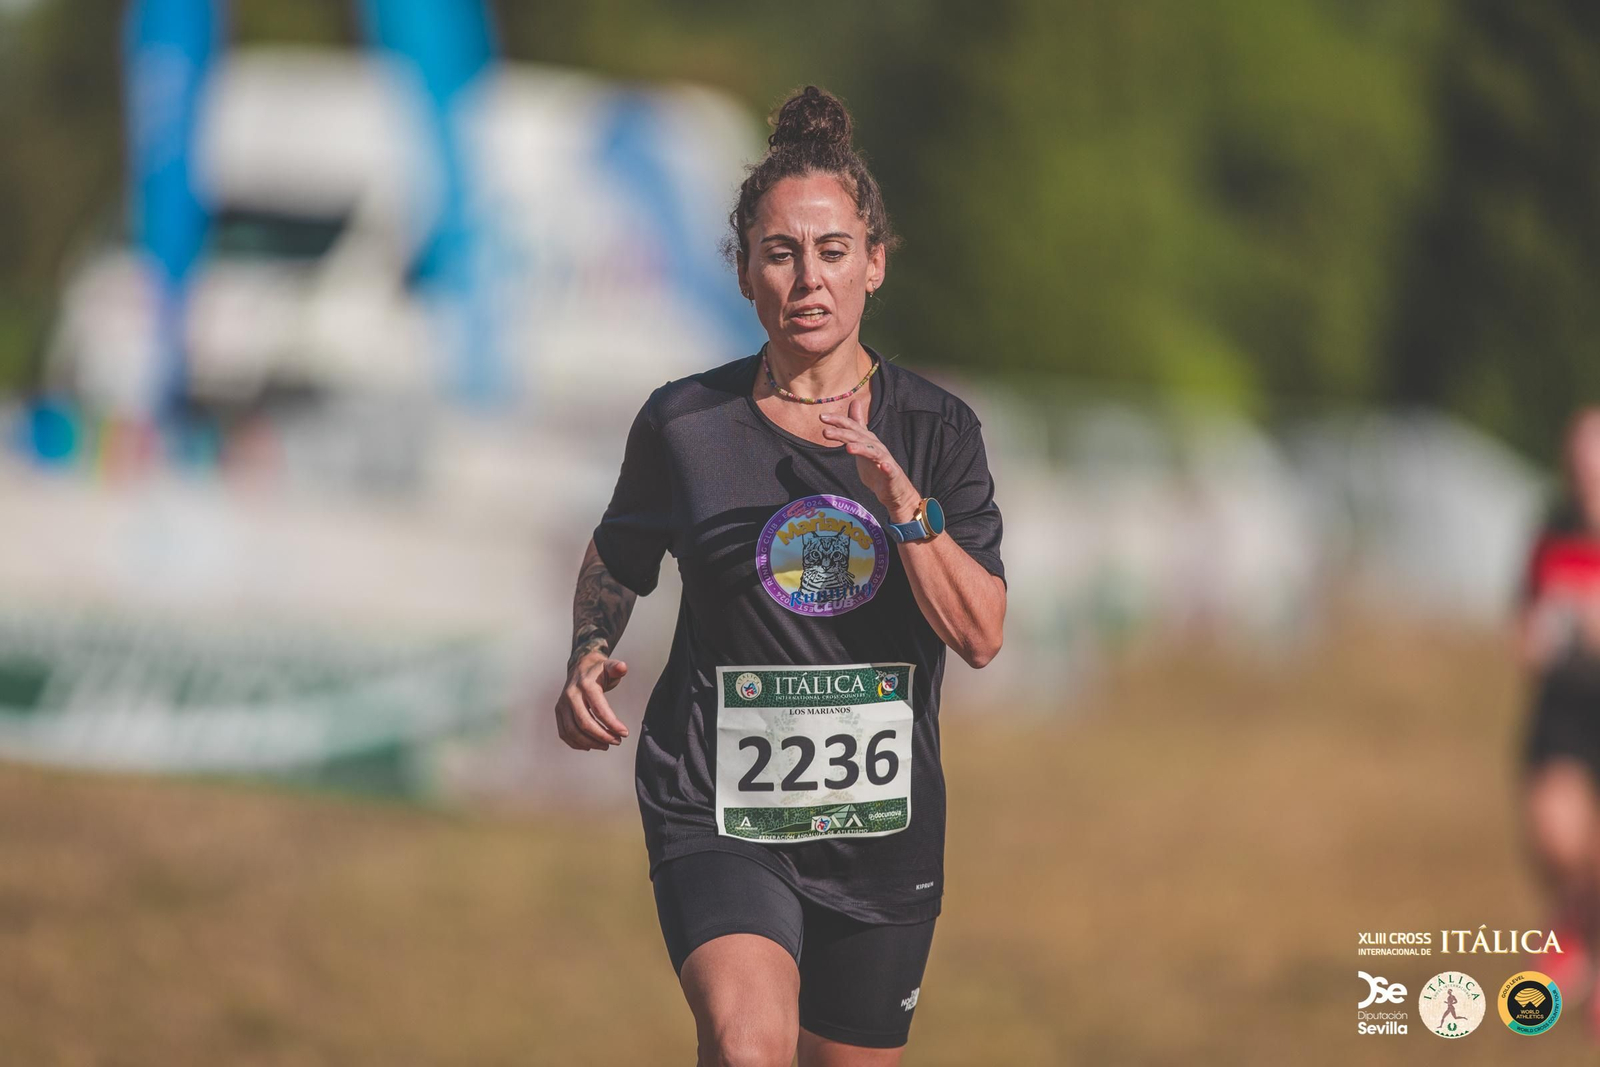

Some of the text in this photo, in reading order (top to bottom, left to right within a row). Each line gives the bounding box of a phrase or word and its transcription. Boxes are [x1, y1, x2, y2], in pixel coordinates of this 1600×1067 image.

[775, 512, 874, 550] Marianos
[760, 523, 778, 587] RUNNING CLUB
[789, 582, 874, 607] Running
[813, 598, 854, 613] CLUB
[775, 672, 866, 696] ITÁLICA
[789, 707, 851, 716] LOS MARIANOS
[738, 729, 899, 792] 2236
